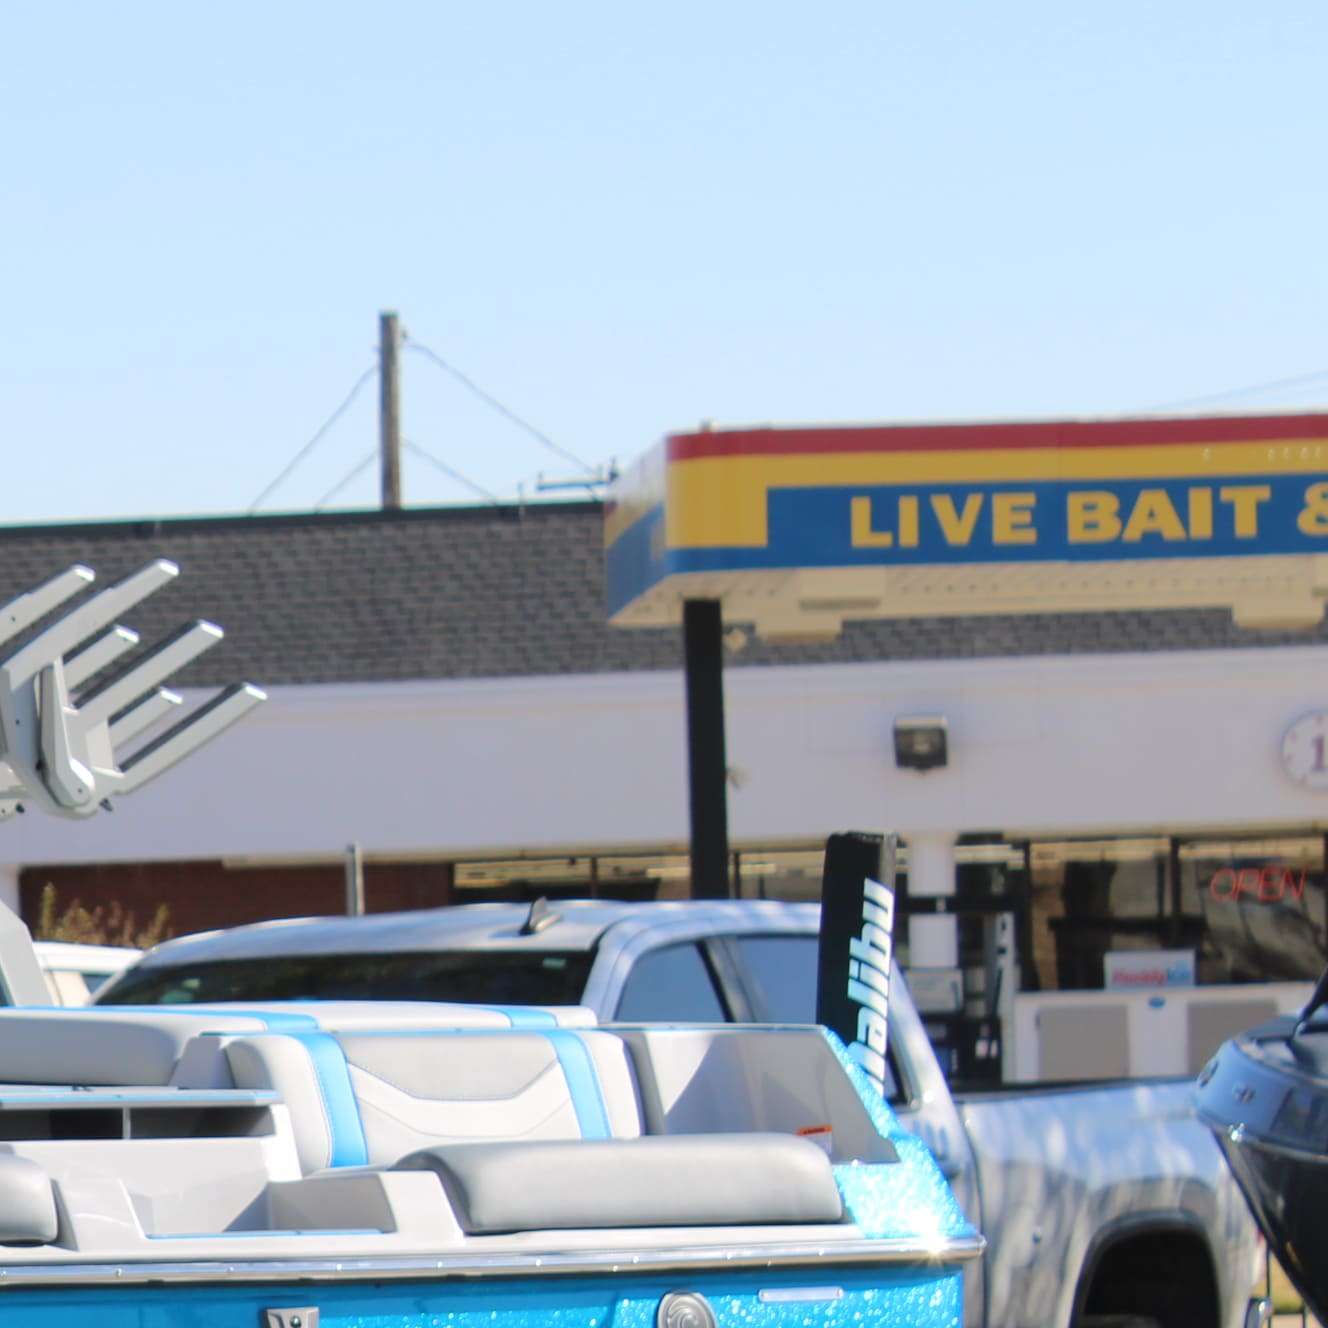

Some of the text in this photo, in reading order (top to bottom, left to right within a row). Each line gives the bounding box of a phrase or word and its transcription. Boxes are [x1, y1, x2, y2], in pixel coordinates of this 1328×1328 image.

[850, 491, 1038, 548] LIVE
[1066, 484, 1272, 544] BAIT
[1209, 864, 1314, 903] OPEN
